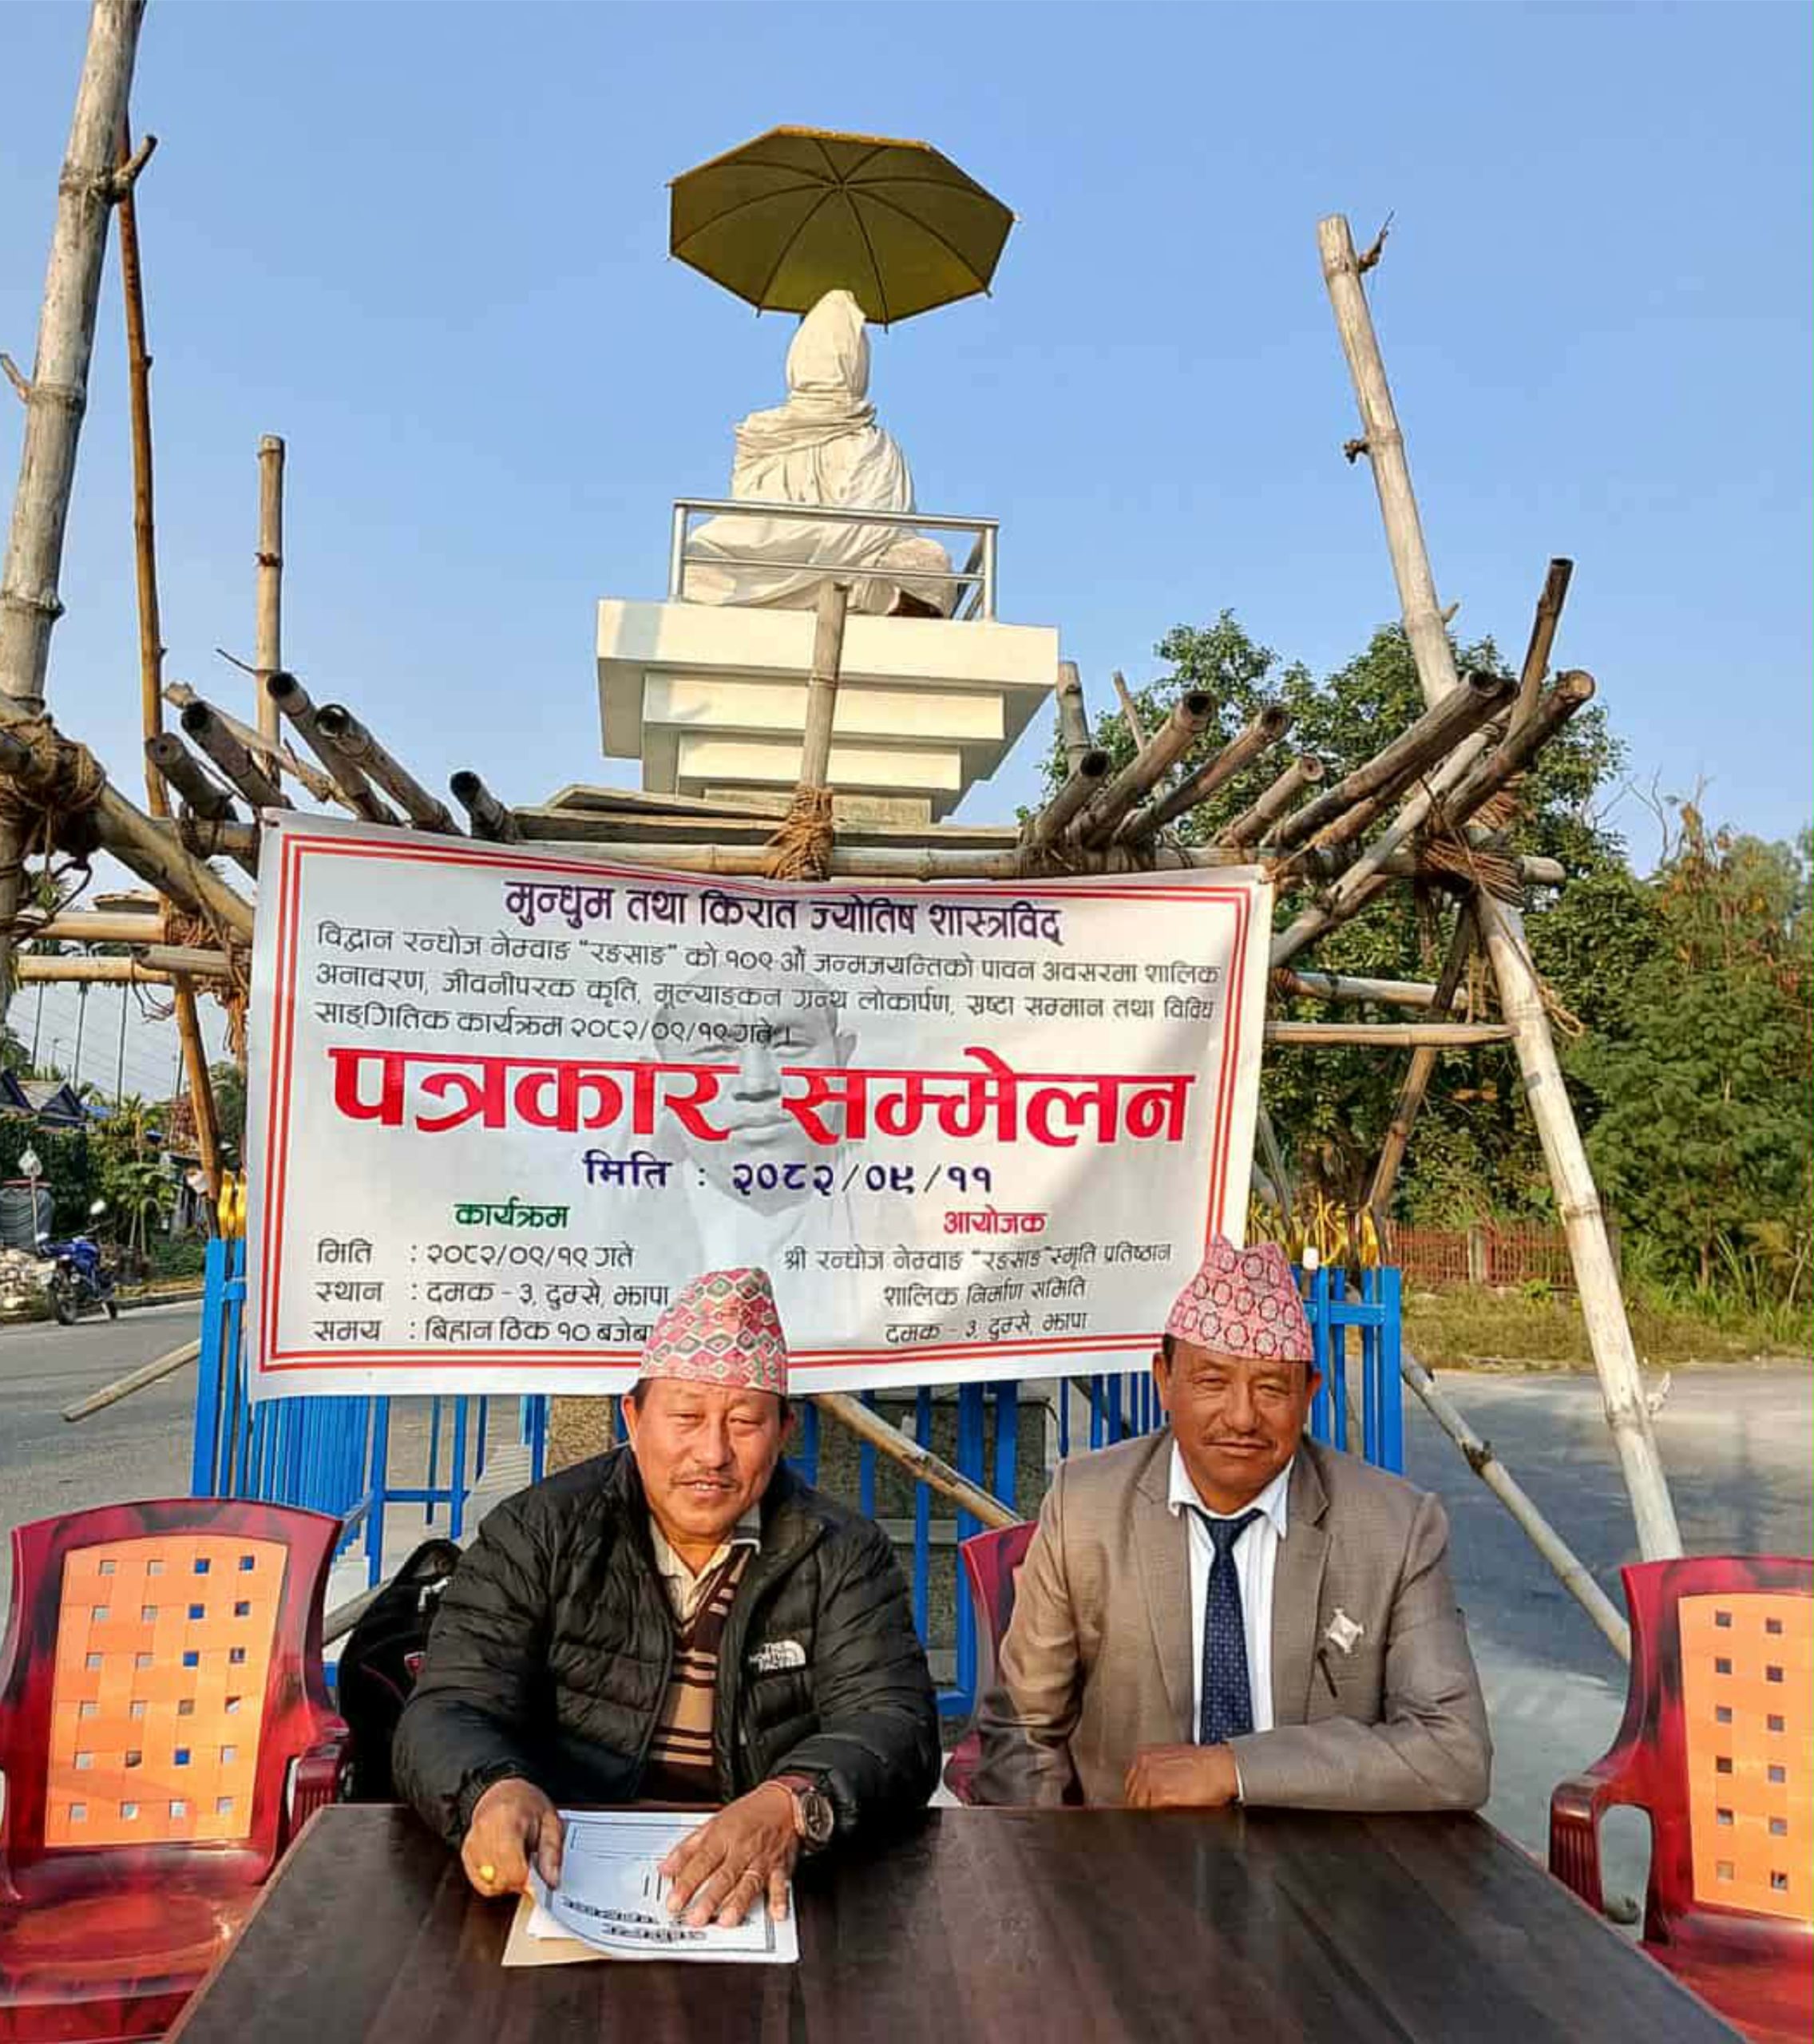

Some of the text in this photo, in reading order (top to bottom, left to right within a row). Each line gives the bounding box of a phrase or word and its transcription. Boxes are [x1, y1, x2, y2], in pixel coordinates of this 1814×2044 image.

[505, 881, 1064, 945] मुन्धुम तथा किरात ज्योतिष शास्त्रविद्
[318, 921, 393, 953] विद्वान
[684, 941, 719, 969] को
[813, 951, 975, 979] जन्मजयन्तिको
[981, 960, 1036, 981] पावन
[1041, 961, 1137, 983] अवसरमा
[1145, 961, 1221, 984] शालिक
[316, 963, 428, 996] अनावरण,
[442, 969, 575, 998] जीवनीपरक
[790, 988, 851, 1010] ग्रन्थ
[857, 984, 955, 1017] लोकार्पण,
[1024, 997, 1103, 1018] सम्मान
[1112, 999, 1155, 1018] तथा
[1164, 996, 1215, 1020] विविध
[455, 1007, 562, 1037] कार्यक्रम
[328, 1047, 1196, 1147] पत्रकार सम्मेलन
[582, 1149, 673, 1188] मिति
[454, 1196, 571, 1228] कार्यक्रम
[944, 1204, 1048, 1234] आयोजक
[318, 1238, 373, 1263] मिति
[594, 1240, 636, 1268] गते
[784, 1246, 808, 1270] श्री
[1103, 1240, 1172, 1263] प्रतिष्ठान
[315, 1281, 385, 1301] स्थान
[426, 1281, 497, 1302] दमक
[612, 1285, 670, 1306] झापा
[884, 1275, 1087, 1307] शालिक निर्माण समिति
[310, 1321, 382, 1341] समय
[425, 1316, 493, 1342] बिहान
[499, 1317, 554, 1341] ठिक
[558, 1322, 591, 1342] १०
[597, 1317, 655, 1343] बजेबा
[885, 1322, 944, 1344] दमक
[1042, 1313, 1088, 1332] झापा
